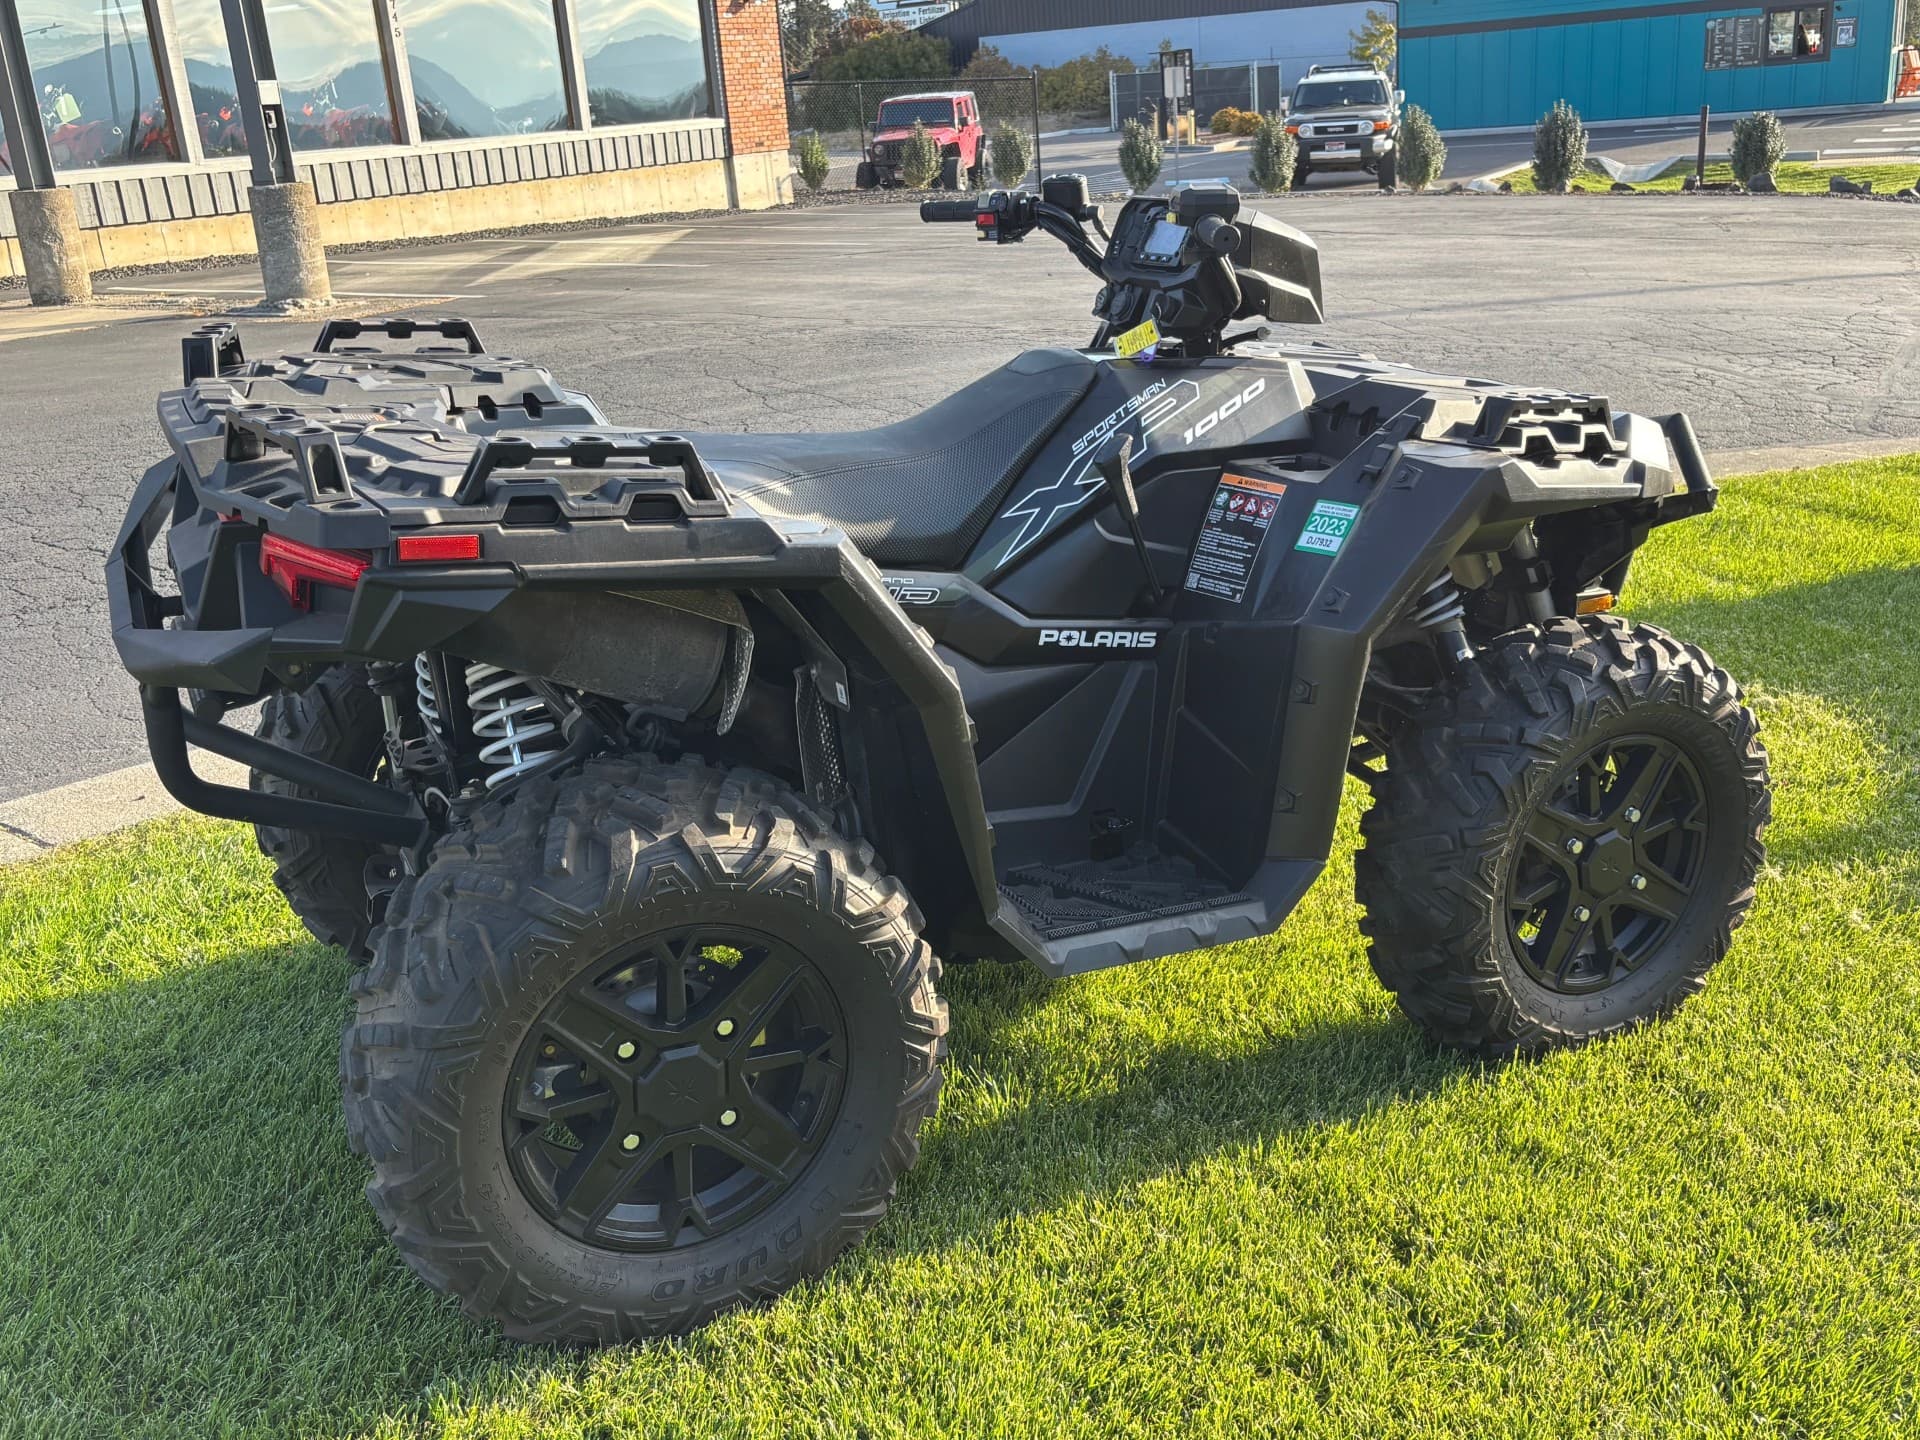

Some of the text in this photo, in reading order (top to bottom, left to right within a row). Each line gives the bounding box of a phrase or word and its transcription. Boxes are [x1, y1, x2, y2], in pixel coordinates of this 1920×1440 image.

[1071, 378, 1167, 454] SPORTSMAN
[1184, 378, 1265, 443] 1000
[1306, 536, 1333, 548] DJ7932
[1307, 516, 1348, 535] 2023
[1038, 629, 1157, 648] POLARIS
[651, 1215, 803, 1302] DURO
